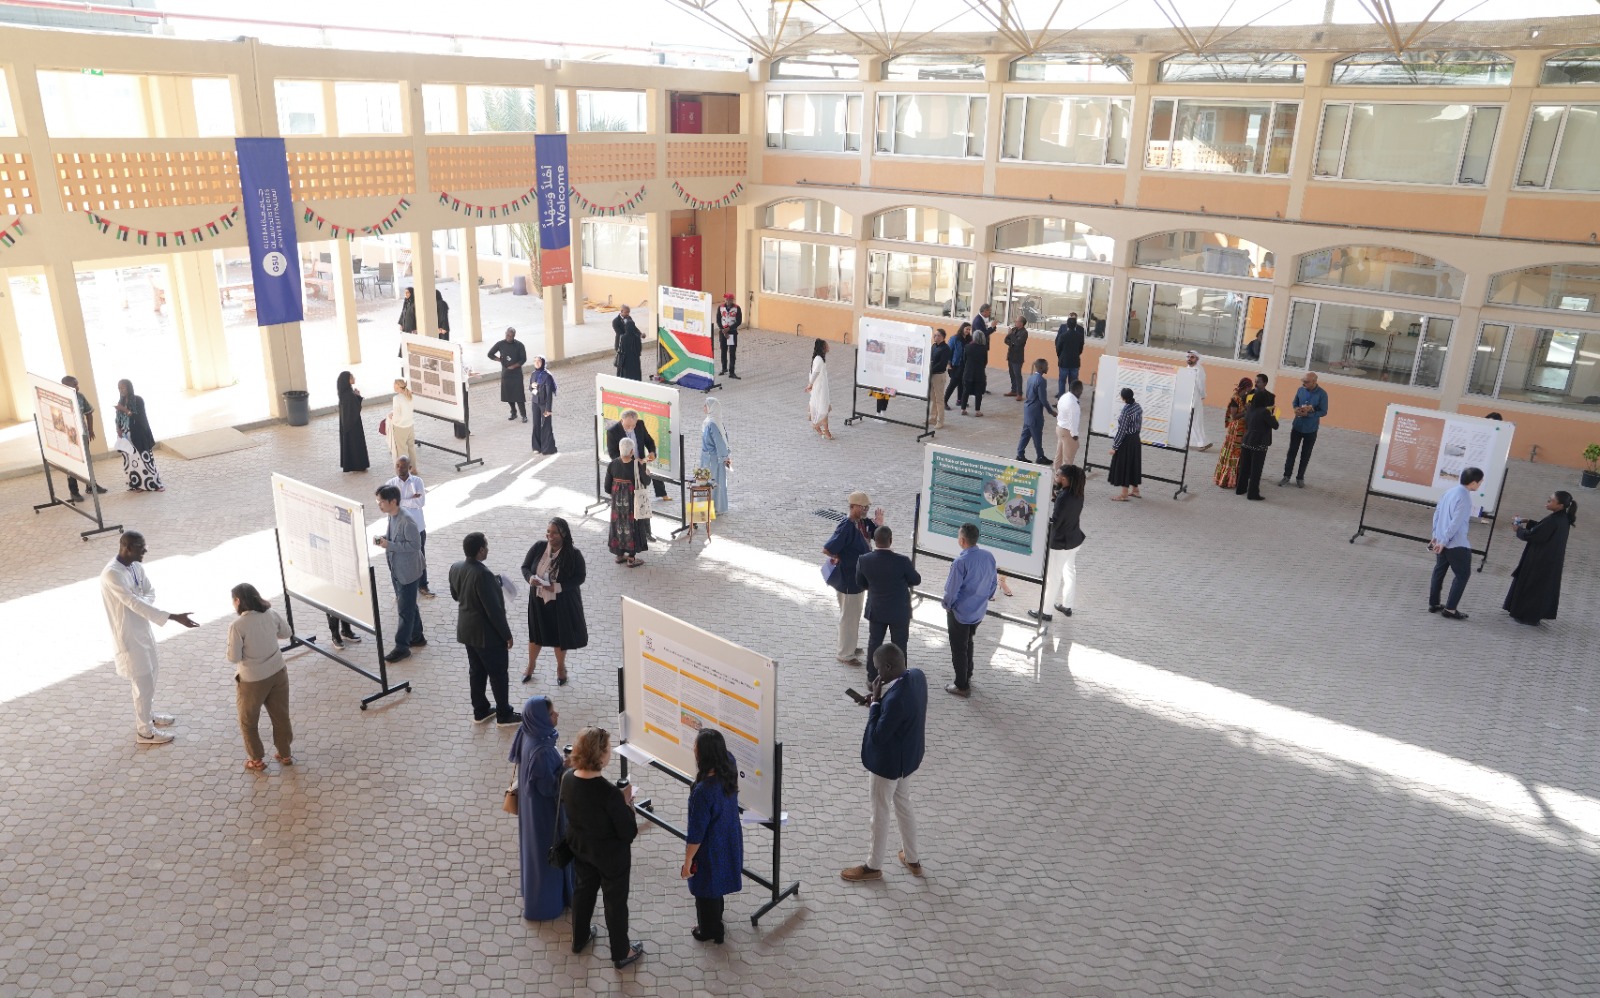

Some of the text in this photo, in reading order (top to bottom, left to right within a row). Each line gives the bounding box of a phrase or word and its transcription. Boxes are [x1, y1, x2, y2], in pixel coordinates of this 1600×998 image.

[264, 188, 273, 217] STUDIES
[556, 165, 566, 227] Welcome
[274, 212, 283, 248] UNIVERSITY
